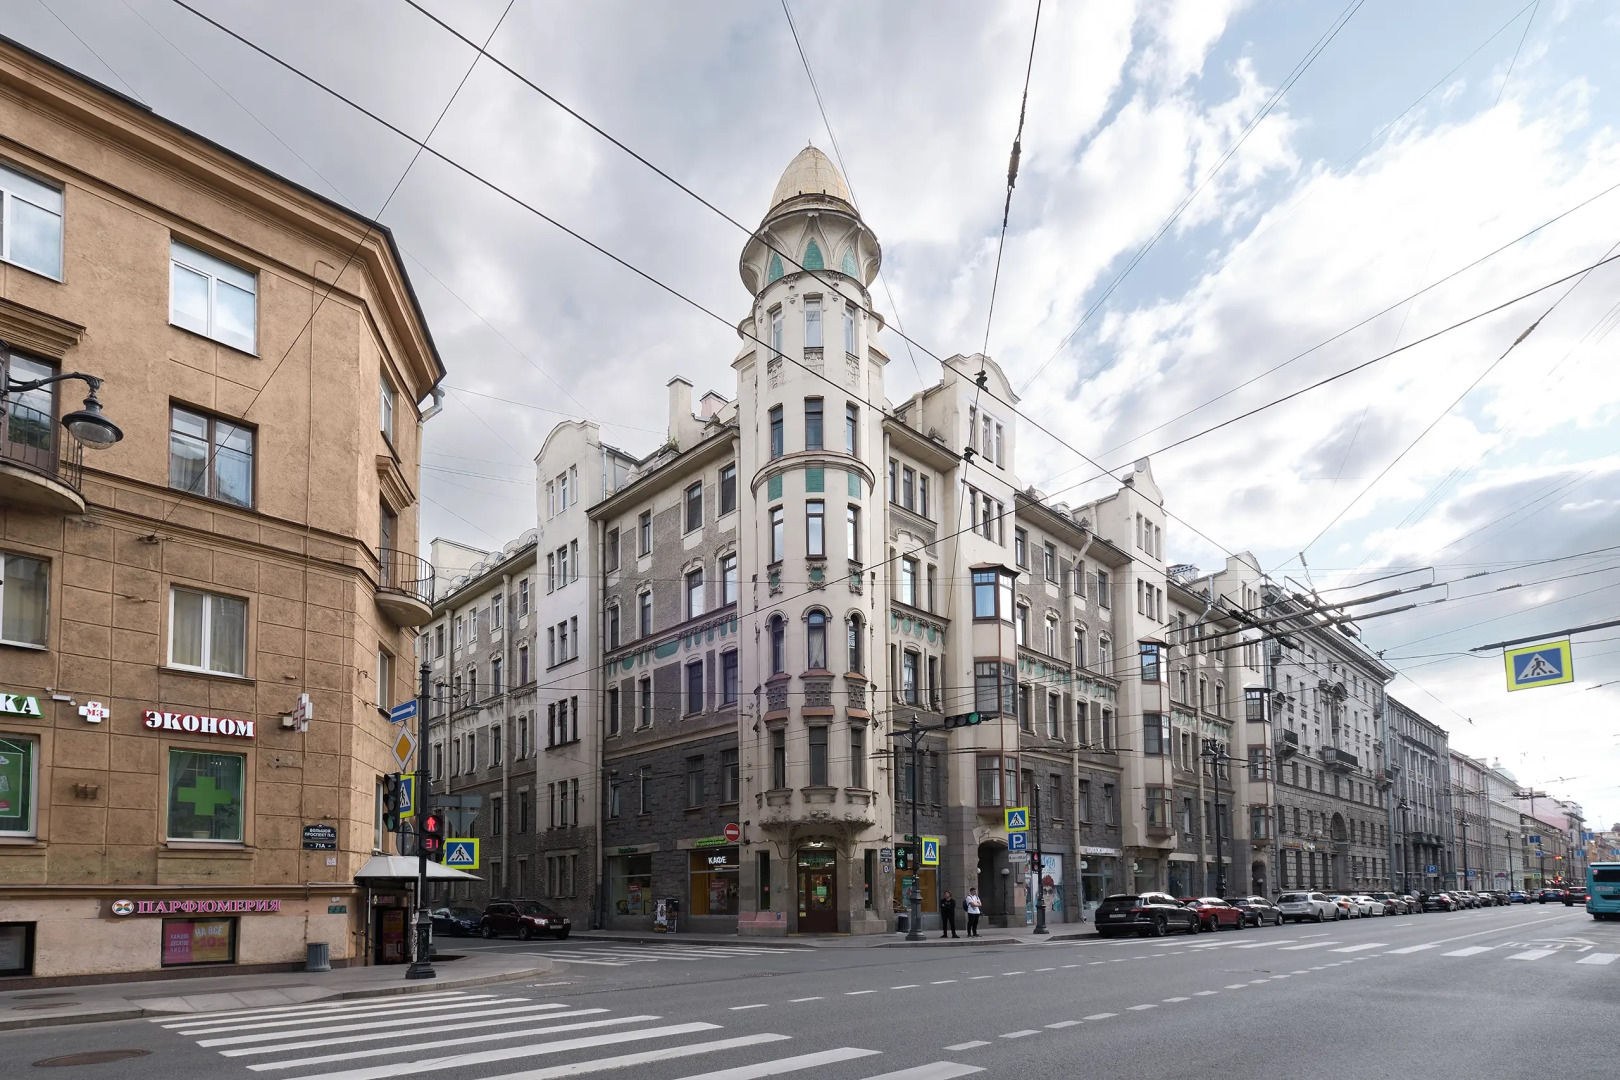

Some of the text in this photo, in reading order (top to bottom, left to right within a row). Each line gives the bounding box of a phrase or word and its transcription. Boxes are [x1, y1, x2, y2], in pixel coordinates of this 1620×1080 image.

[145, 710, 255, 738] ЭКОНОМ
[425, 838, 439, 849] 31
[707, 856, 727, 865] КАФЕ
[137, 900, 281, 914] ПАРФЮМЕРИЯ
